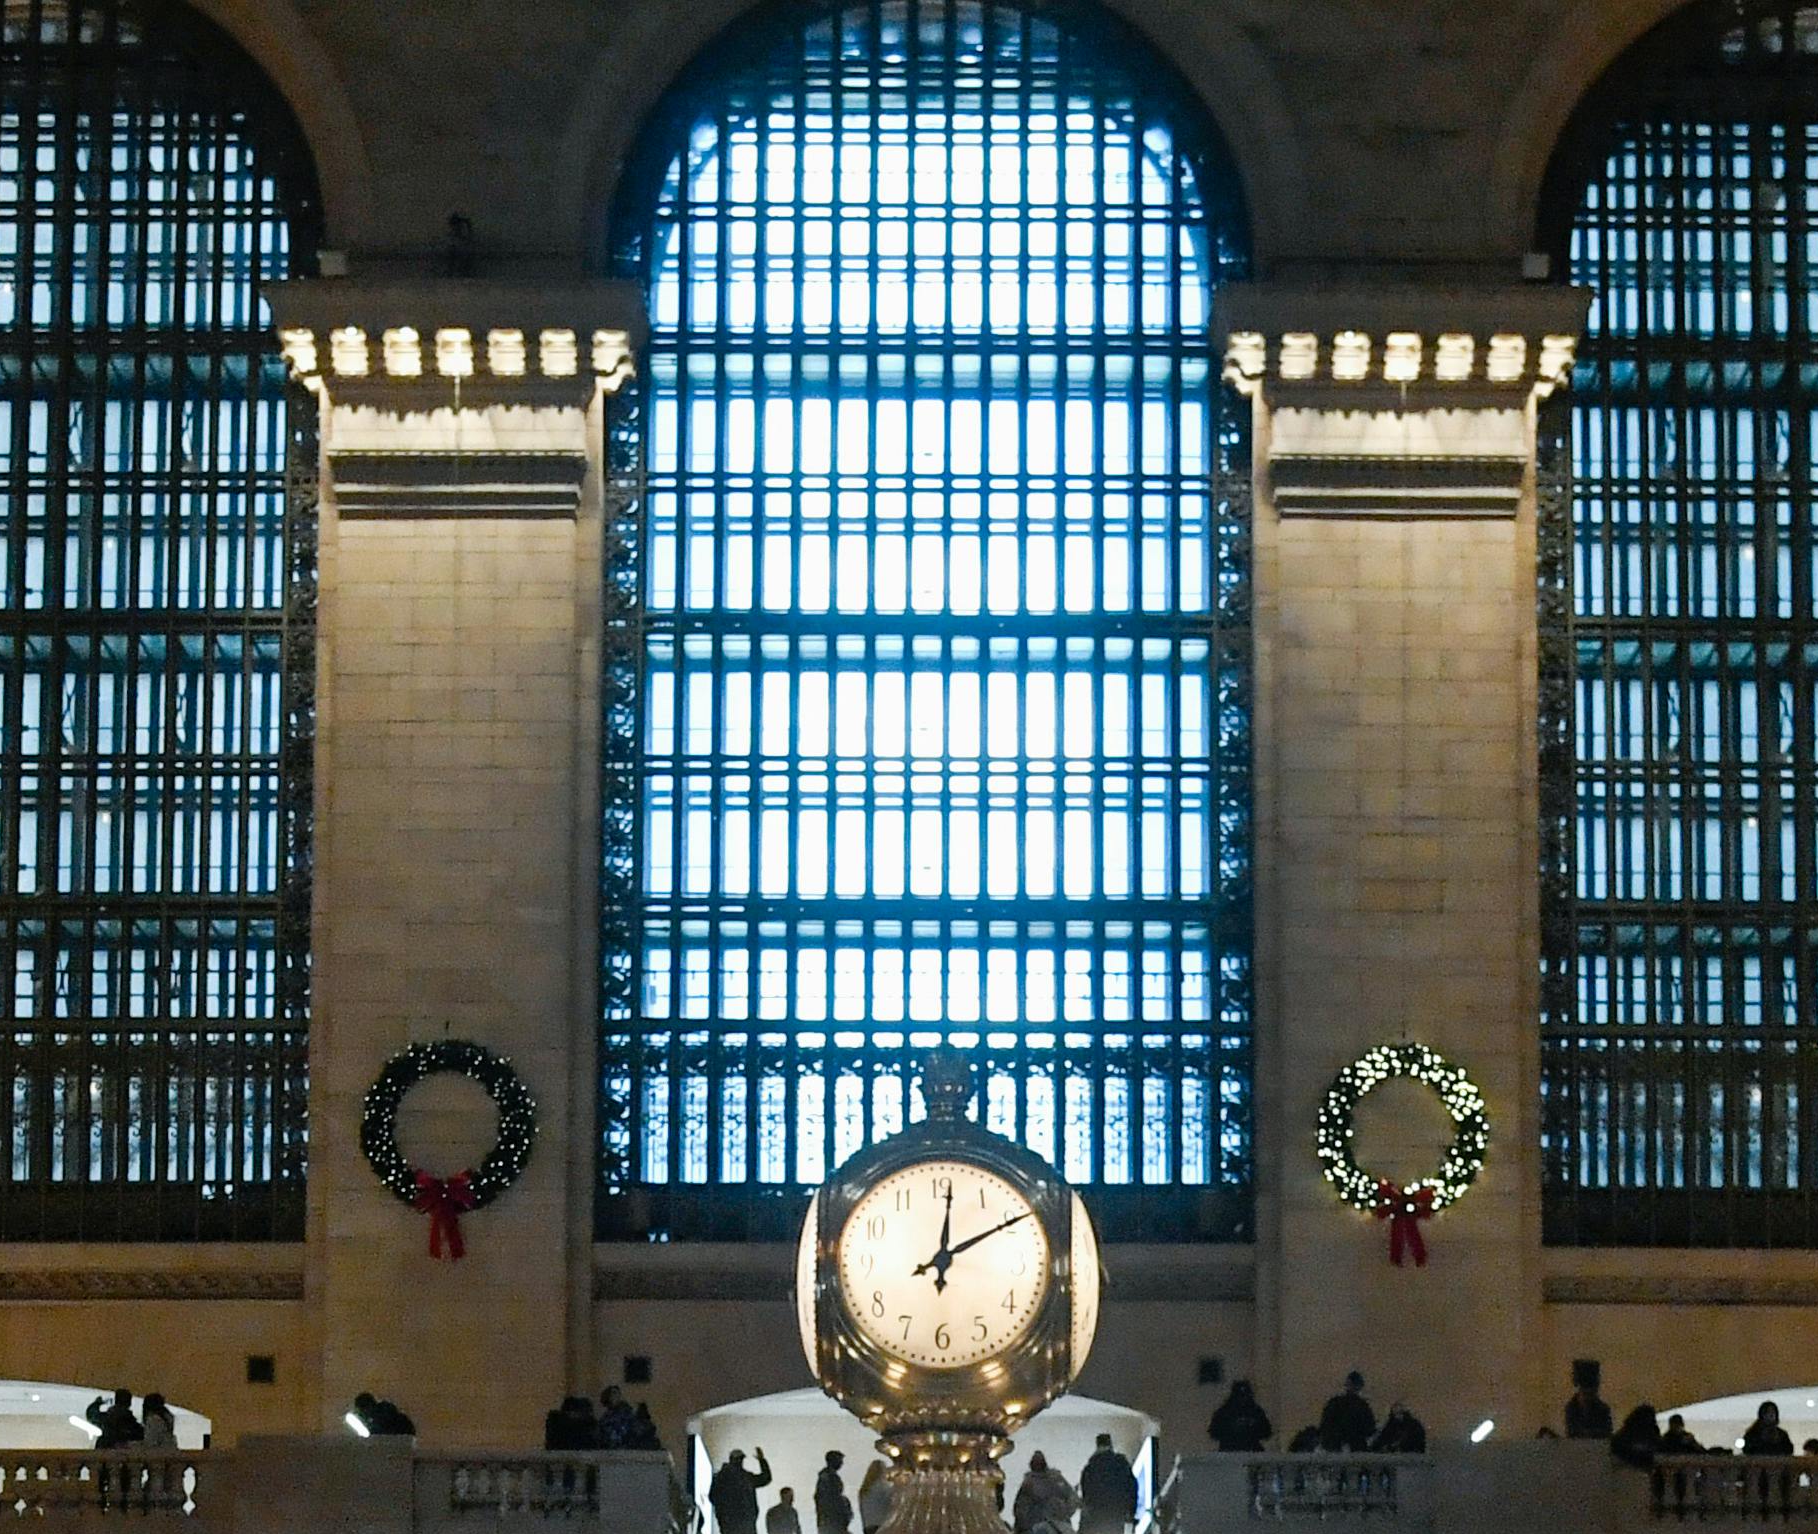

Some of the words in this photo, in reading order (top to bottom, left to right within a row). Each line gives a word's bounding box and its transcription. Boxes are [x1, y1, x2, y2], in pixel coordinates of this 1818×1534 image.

[895, 1188, 911, 1212] 11
[978, 1187, 986, 1209] 1
[866, 1215, 885, 1241] 10
[871, 1290, 885, 1318] 8
[1001, 1288, 1018, 1315] 4
[898, 1315, 912, 1341] 7
[934, 1322, 951, 1350] 6
[971, 1316, 988, 1342] 5
